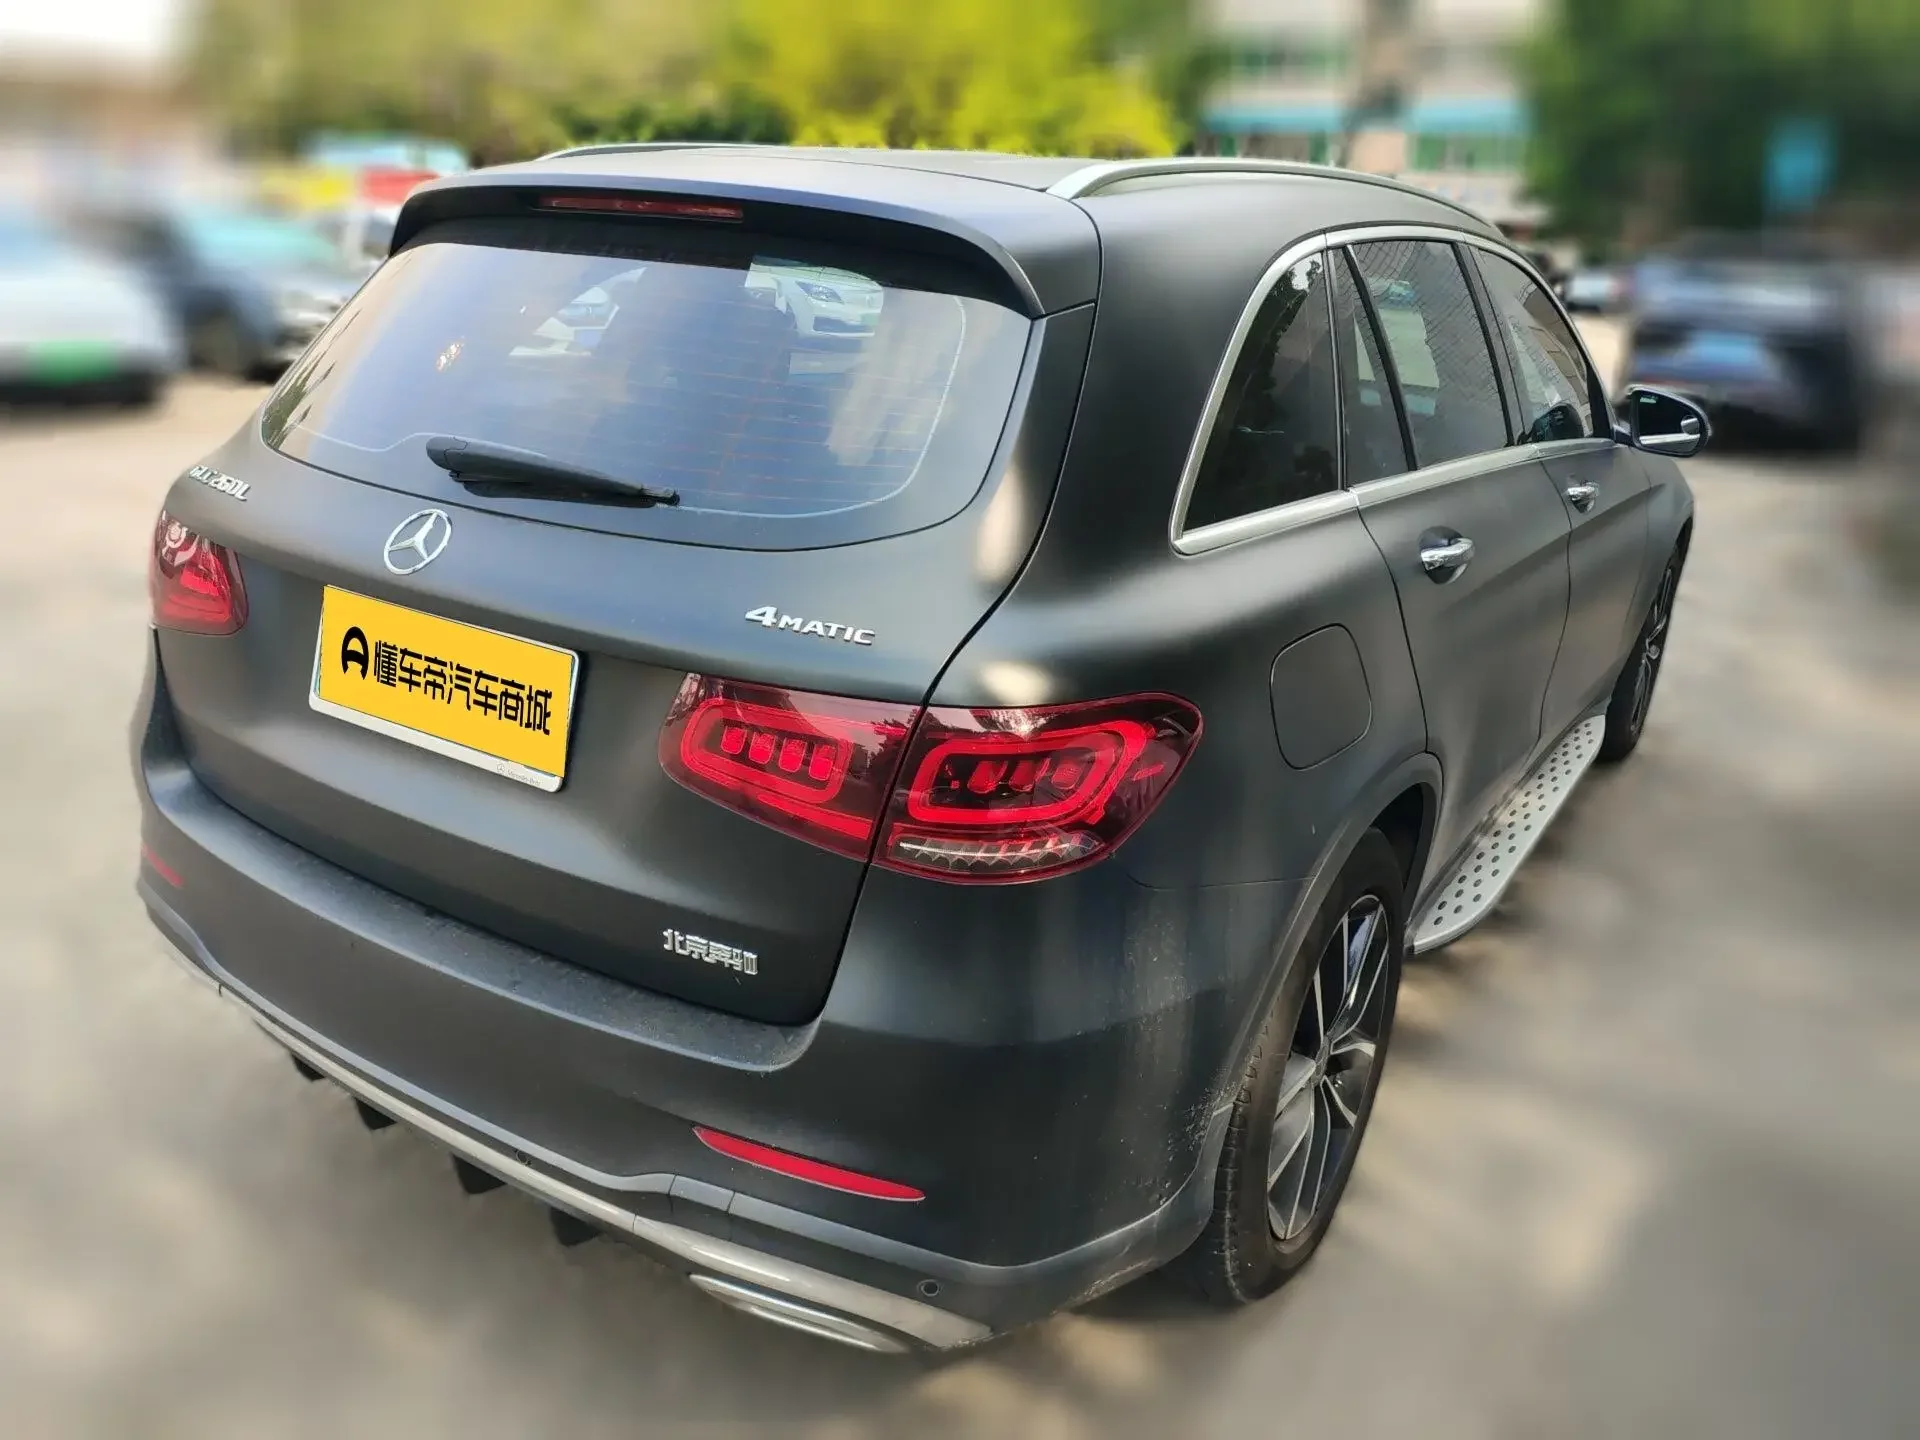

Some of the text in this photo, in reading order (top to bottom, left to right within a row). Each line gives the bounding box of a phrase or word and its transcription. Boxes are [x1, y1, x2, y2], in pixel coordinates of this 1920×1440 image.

[745, 606, 876, 645] 4MATIC
[662, 928, 758, 975] 北京奔驰
